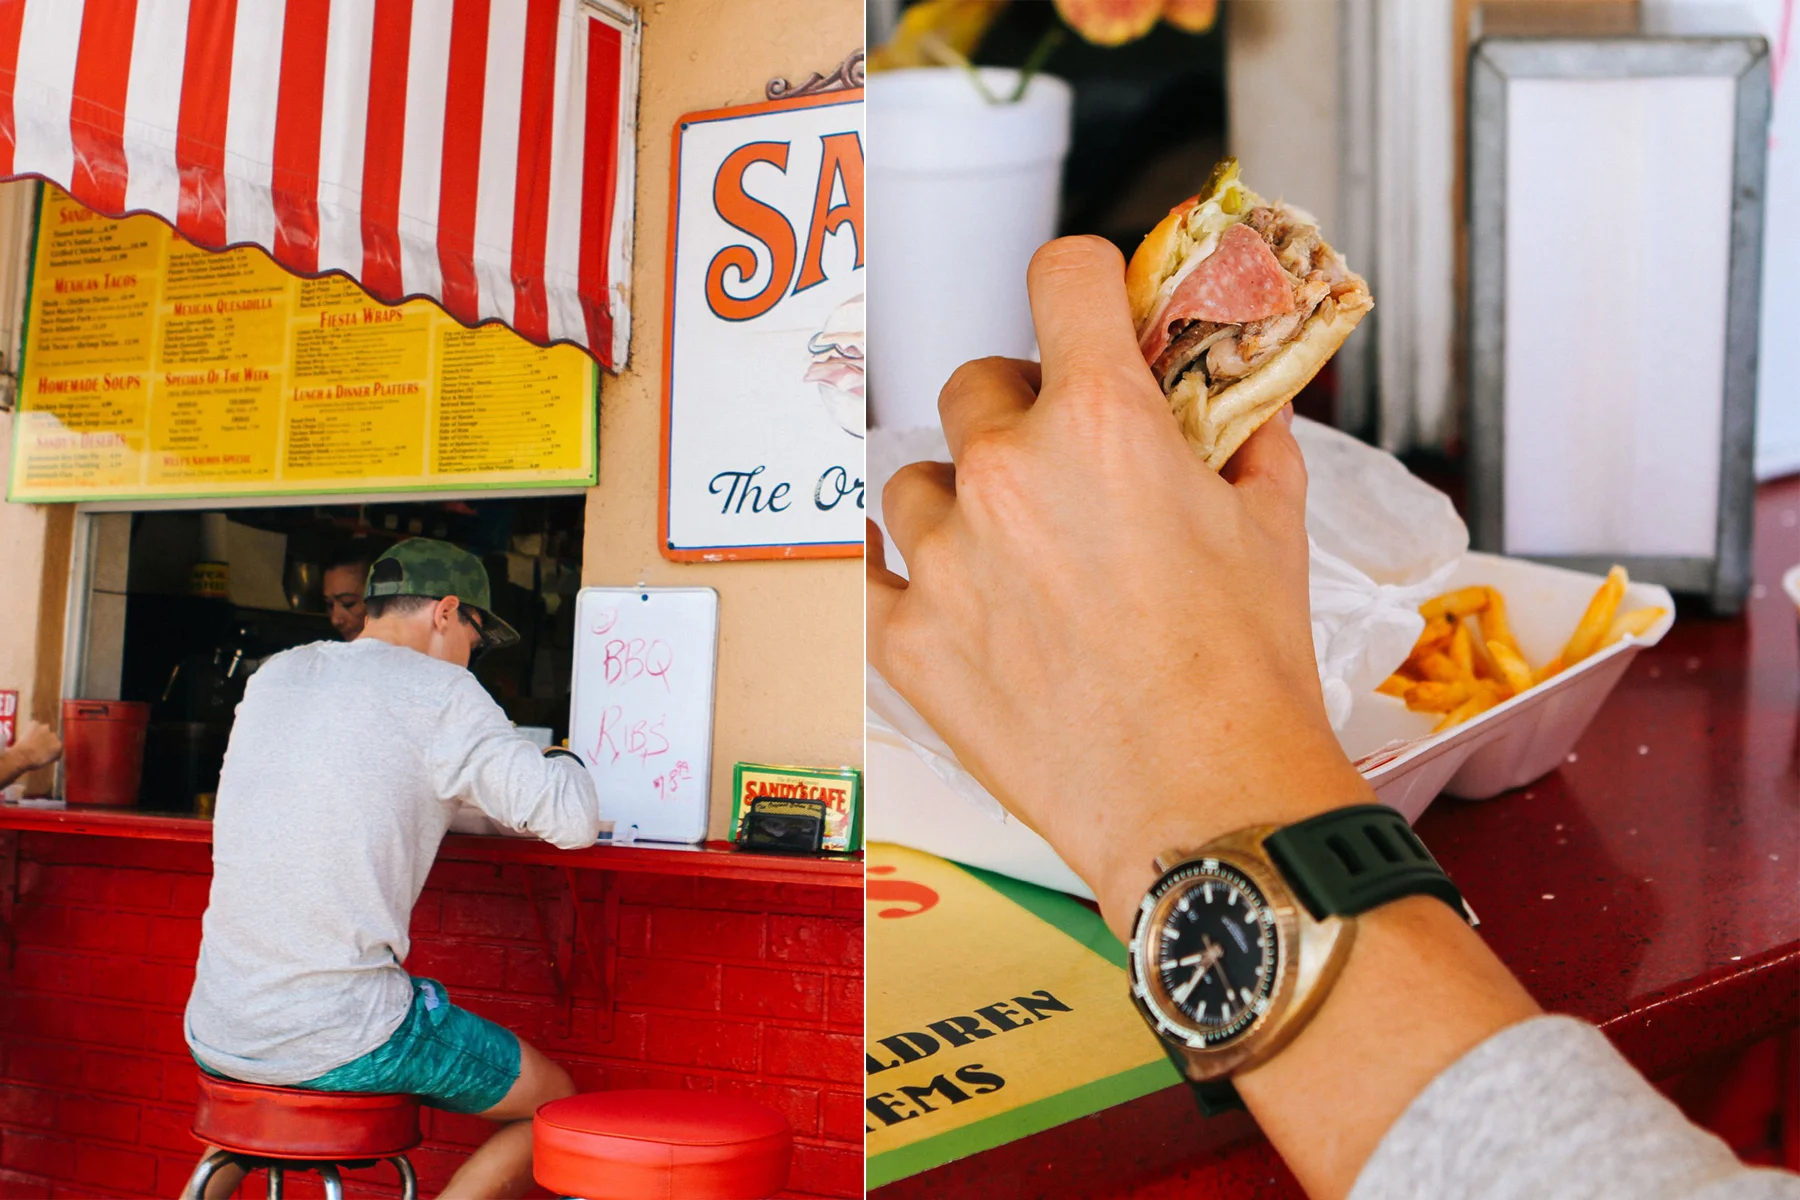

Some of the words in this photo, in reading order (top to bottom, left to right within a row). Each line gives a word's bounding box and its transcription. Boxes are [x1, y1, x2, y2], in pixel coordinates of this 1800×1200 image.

[705, 131, 864, 322] SA
[320, 310, 357, 328] FIESTA
[363, 307, 403, 325] WRAPS
[37, 376, 99, 395] HOMEMADE
[103, 373, 141, 391] SOUPS
[293, 387, 324, 402] LUNCH
[335, 384, 371, 399] DINNER
[373, 381, 420, 397] PLATTERS
[708, 465, 792, 514] The
[604, 638, 673, 694] BBQ
[587, 704, 669, 769] RIBS
[809, 786, 847, 815] CAFE
